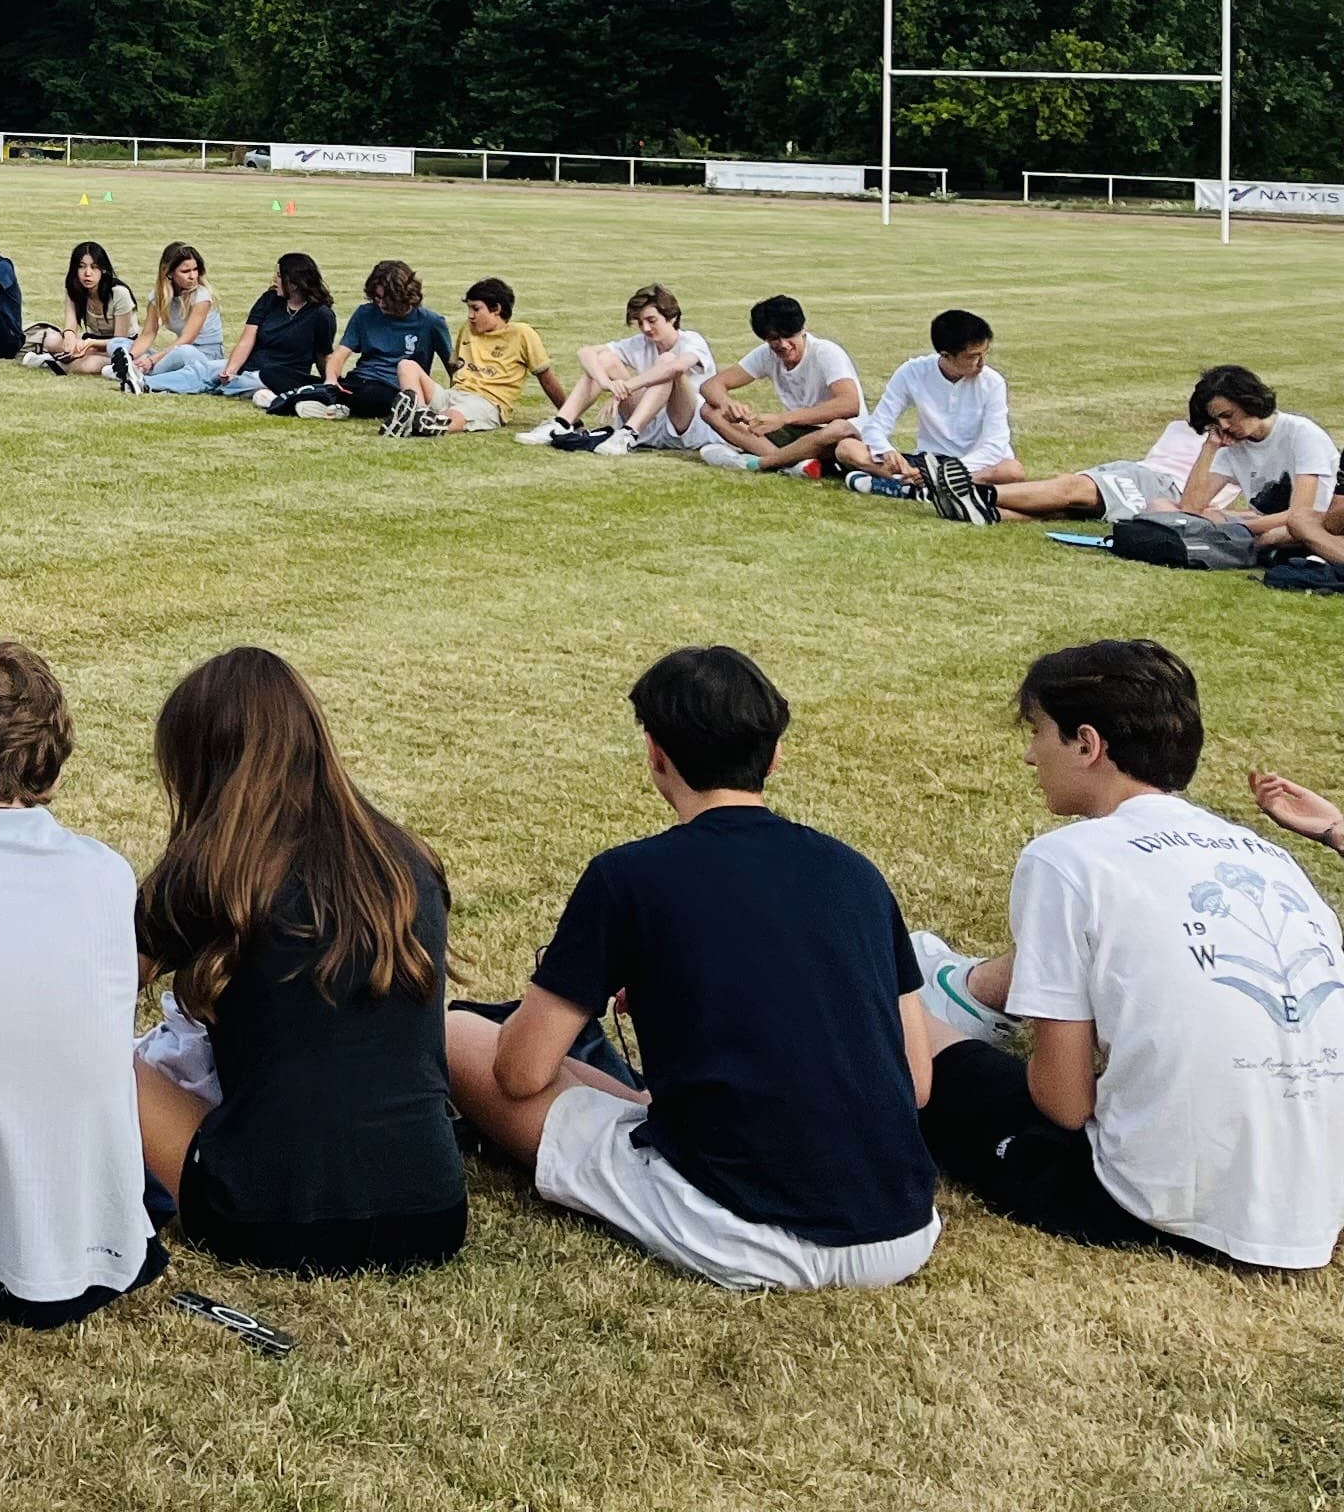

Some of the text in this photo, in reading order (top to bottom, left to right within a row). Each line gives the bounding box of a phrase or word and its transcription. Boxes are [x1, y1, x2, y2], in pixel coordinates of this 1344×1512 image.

[322, 151, 387, 163] NATIXIS
[1259, 190, 1340, 203] NATIXIS
[1127, 831, 1190, 854] Wild
[1188, 832, 1239, 850] East
[1183, 921, 1207, 936] 19
[1188, 944, 1216, 971] W
[1281, 995, 1300, 1022] E
